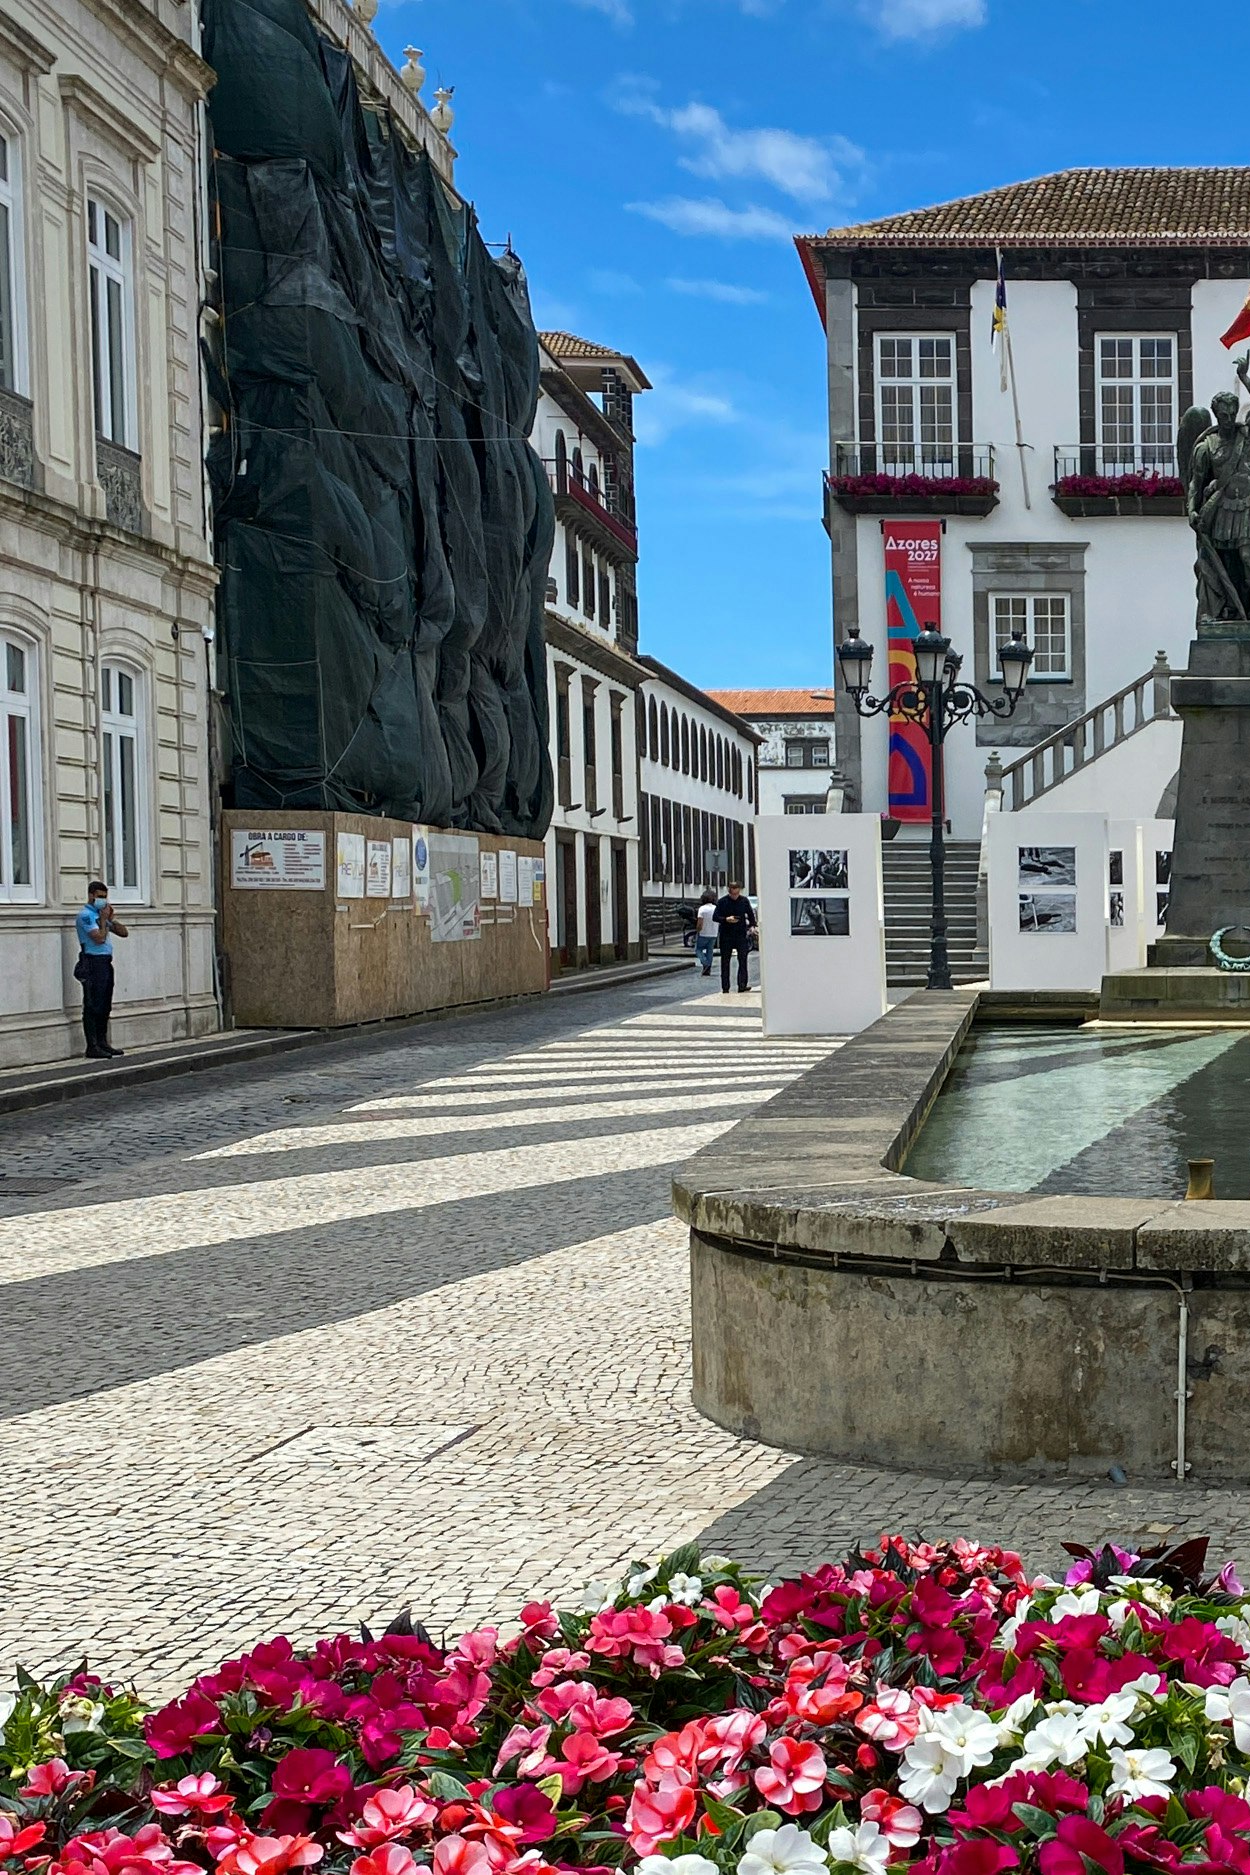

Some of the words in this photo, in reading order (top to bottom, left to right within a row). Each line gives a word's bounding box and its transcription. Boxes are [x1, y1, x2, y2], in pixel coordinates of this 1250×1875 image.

[885, 535, 938, 550] Azores
[907, 551, 938, 561] 2027
[248, 832, 266, 840] OBRA
[267, 832, 272, 841] A
[273, 832, 296, 841] CARGO
